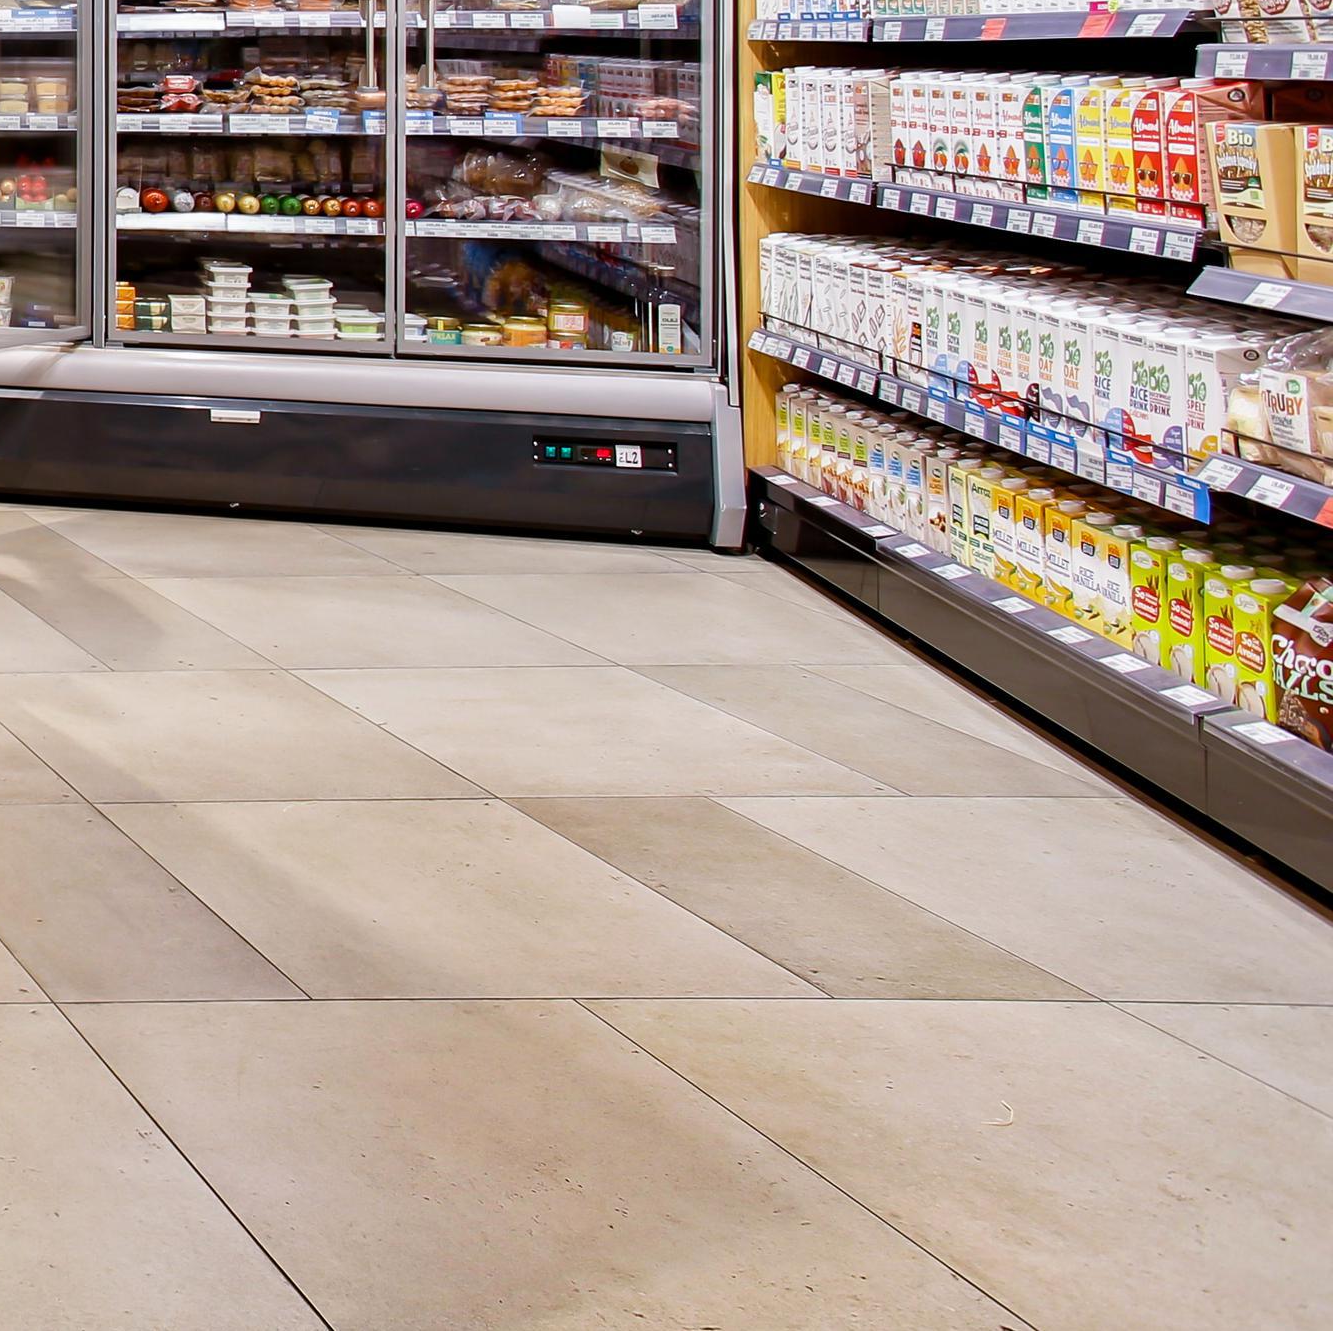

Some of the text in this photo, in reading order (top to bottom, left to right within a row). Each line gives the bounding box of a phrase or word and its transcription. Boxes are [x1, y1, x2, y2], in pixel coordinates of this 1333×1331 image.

[1227, 129, 1253, 146] Bio
[1129, 386, 1148, 401] RICE
[1129, 399, 1148, 412] DRINK
[1187, 400, 1206, 414] SPELT
